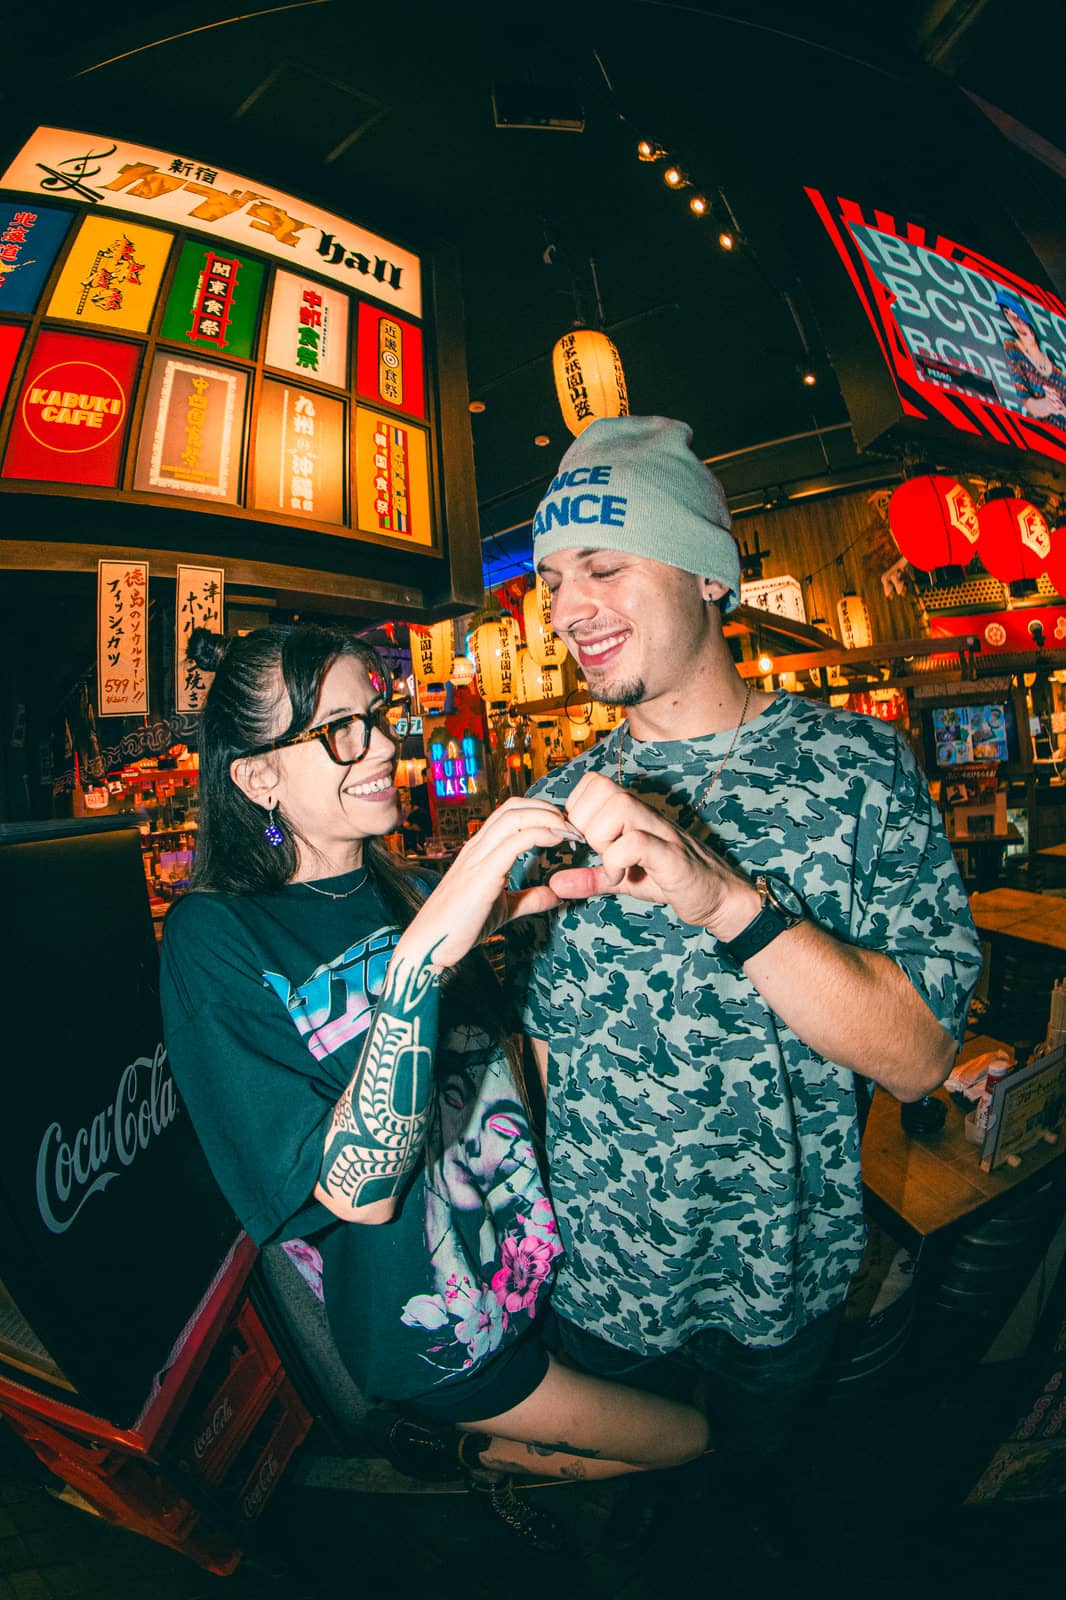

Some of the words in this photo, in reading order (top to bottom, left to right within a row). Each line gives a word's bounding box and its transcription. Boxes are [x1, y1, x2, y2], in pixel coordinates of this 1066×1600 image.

[168, 158, 219, 186] 新宿
[314, 229, 405, 292] hall
[199, 260, 232, 339] 関東食祭
[296, 290, 323, 372] 中部食祭
[29, 386, 121, 415] KABUKI
[41, 406, 104, 429] CAFE
[107, 579, 125, 668] フィッシュカツ
[105, 678, 130, 694] 599
